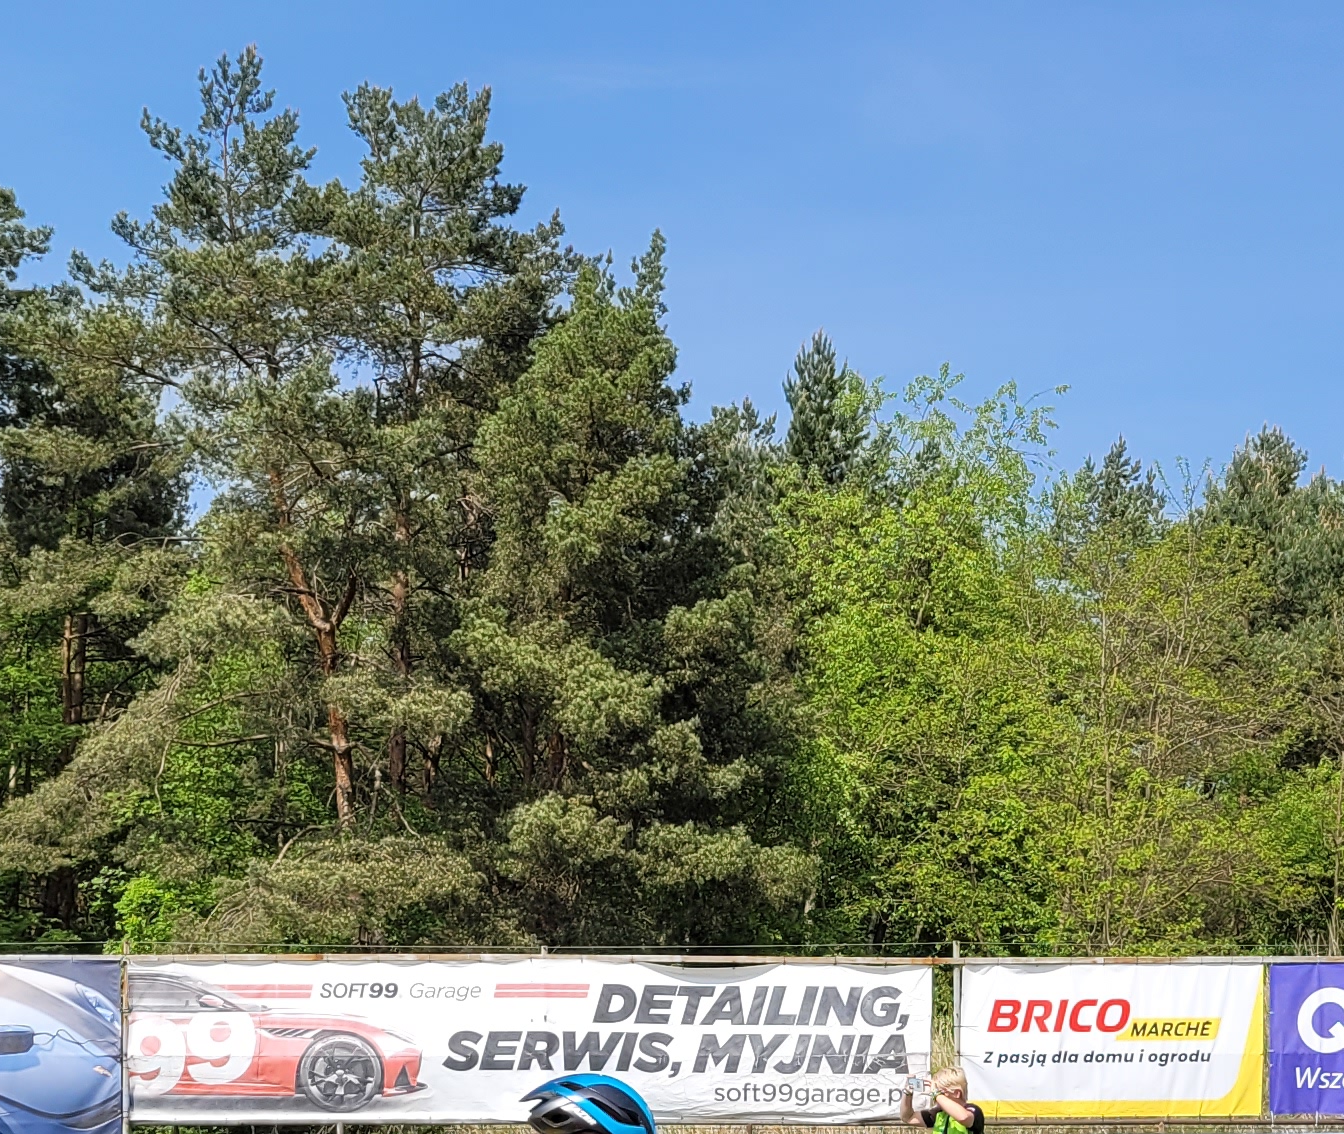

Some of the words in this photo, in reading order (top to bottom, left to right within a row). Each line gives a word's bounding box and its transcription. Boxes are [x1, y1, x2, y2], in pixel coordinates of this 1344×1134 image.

[319, 982, 398, 999] SOFT99
[410, 982, 481, 1002] Garage
[592, 984, 910, 1031] DETAILING,
[987, 998, 1131, 1033] BRICO
[442, 1030, 682, 1078] SERWIS,
[692, 1033, 909, 1074] MYJNIA
[983, 1051, 994, 1064] Z
[997, 1050, 1046, 1067] pasją
[1052, 1050, 1078, 1064] dla
[1083, 1050, 1134, 1063] domu
[1138, 1049, 1145, 1062] i
[1150, 1049, 1211, 1066] ogrodu
[714, 1083, 903, 1107] soft99garage.p
